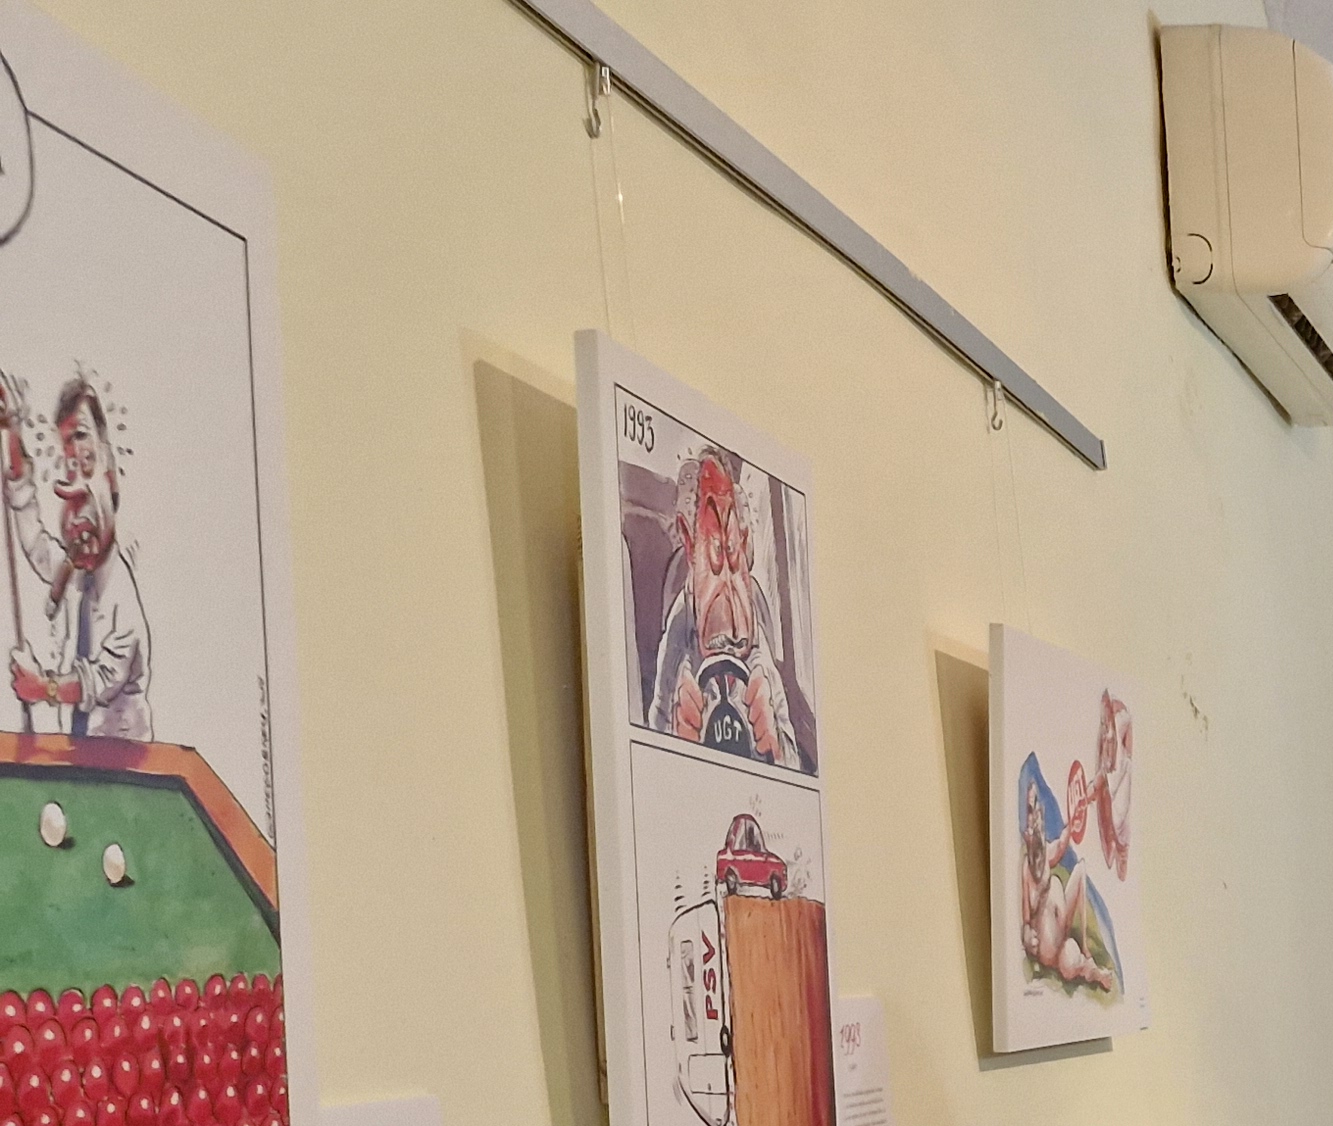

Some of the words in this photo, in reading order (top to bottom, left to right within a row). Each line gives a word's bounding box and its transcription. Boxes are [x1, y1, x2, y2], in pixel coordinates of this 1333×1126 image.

[623, 403, 655, 454] 1993
[713, 714, 743, 744] UGT
[701, 930, 719, 1021] PSV
